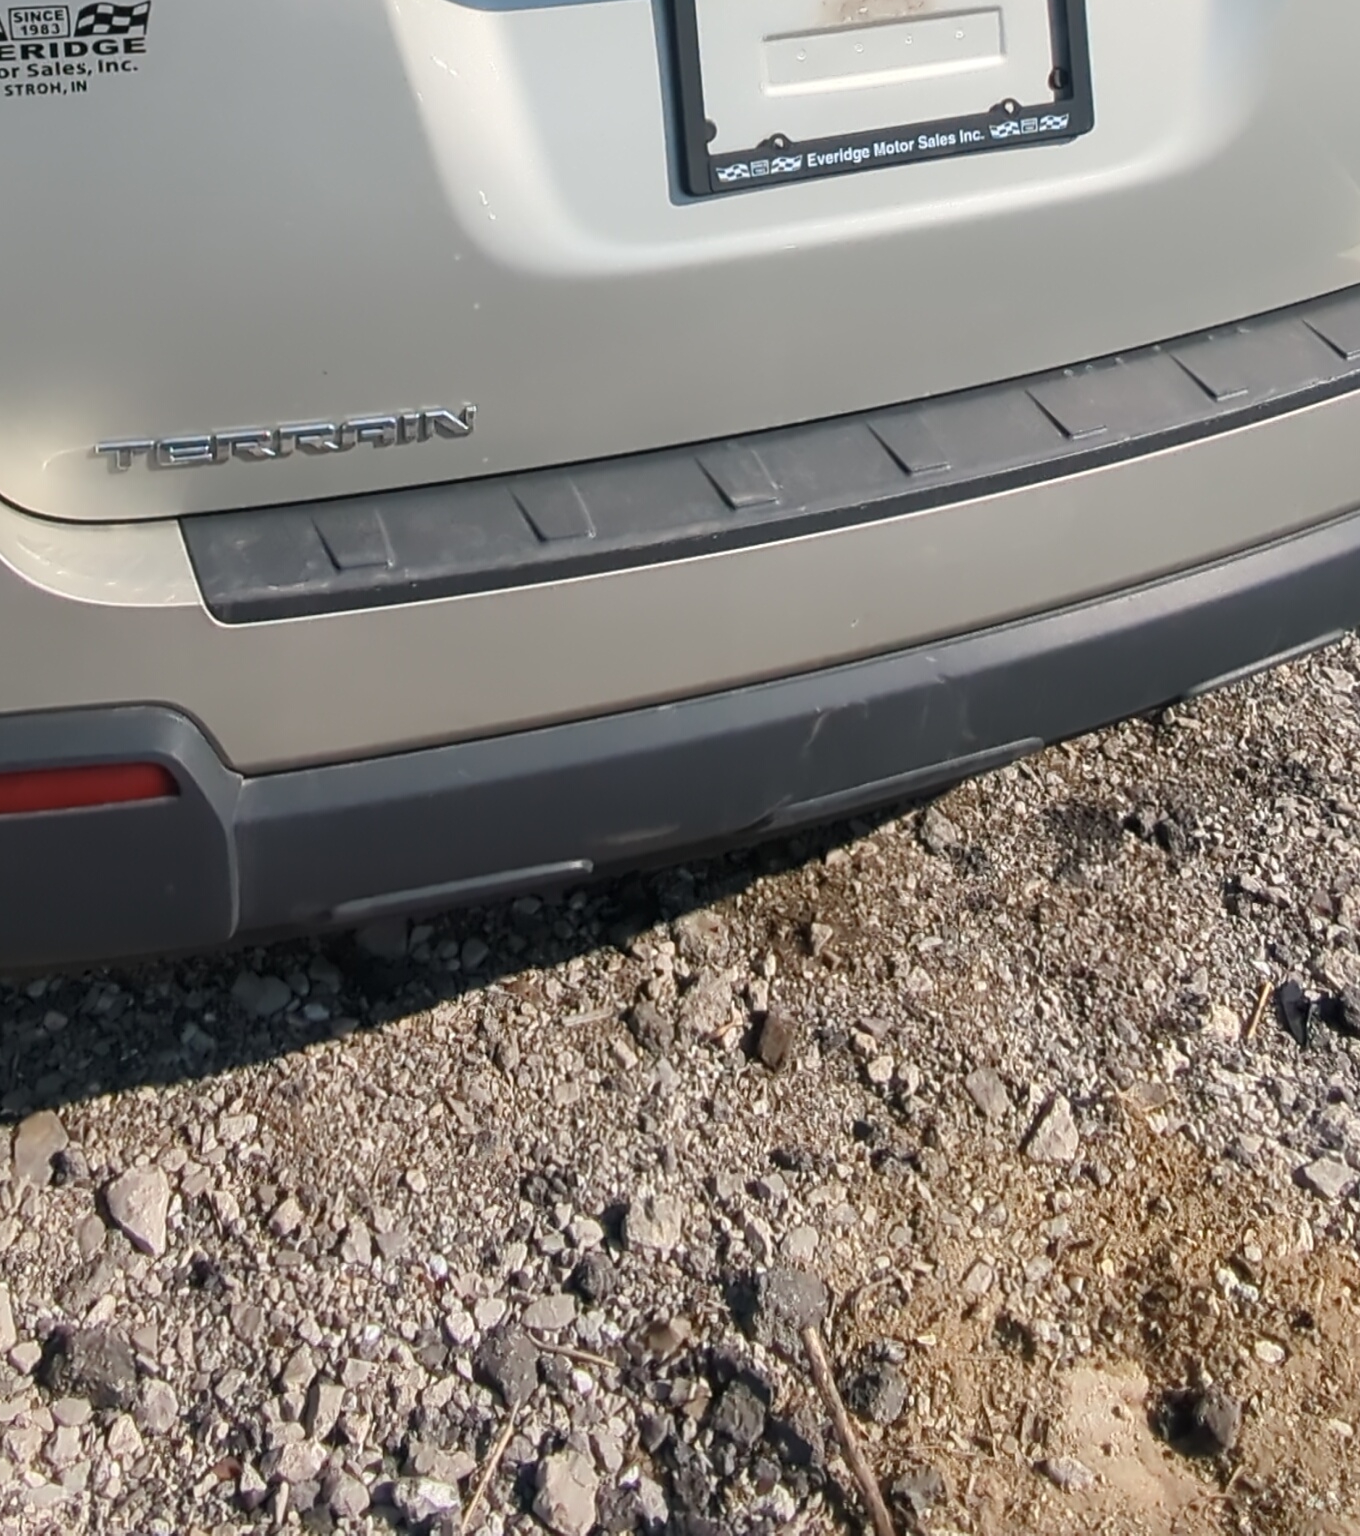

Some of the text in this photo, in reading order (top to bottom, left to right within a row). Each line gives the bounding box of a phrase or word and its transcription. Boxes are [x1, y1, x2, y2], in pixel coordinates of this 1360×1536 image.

[13, 9, 65, 24] SINCE
[20, 23, 61, 36] 1983
[27, 62, 93, 78] Sales,
[98, 59, 139, 73] Inc.
[4, 80, 87, 97] STROH, IN
[807, 128, 986, 168] Everidge Motor Sales Inc.
[94, 402, 478, 471] TERRAIN
